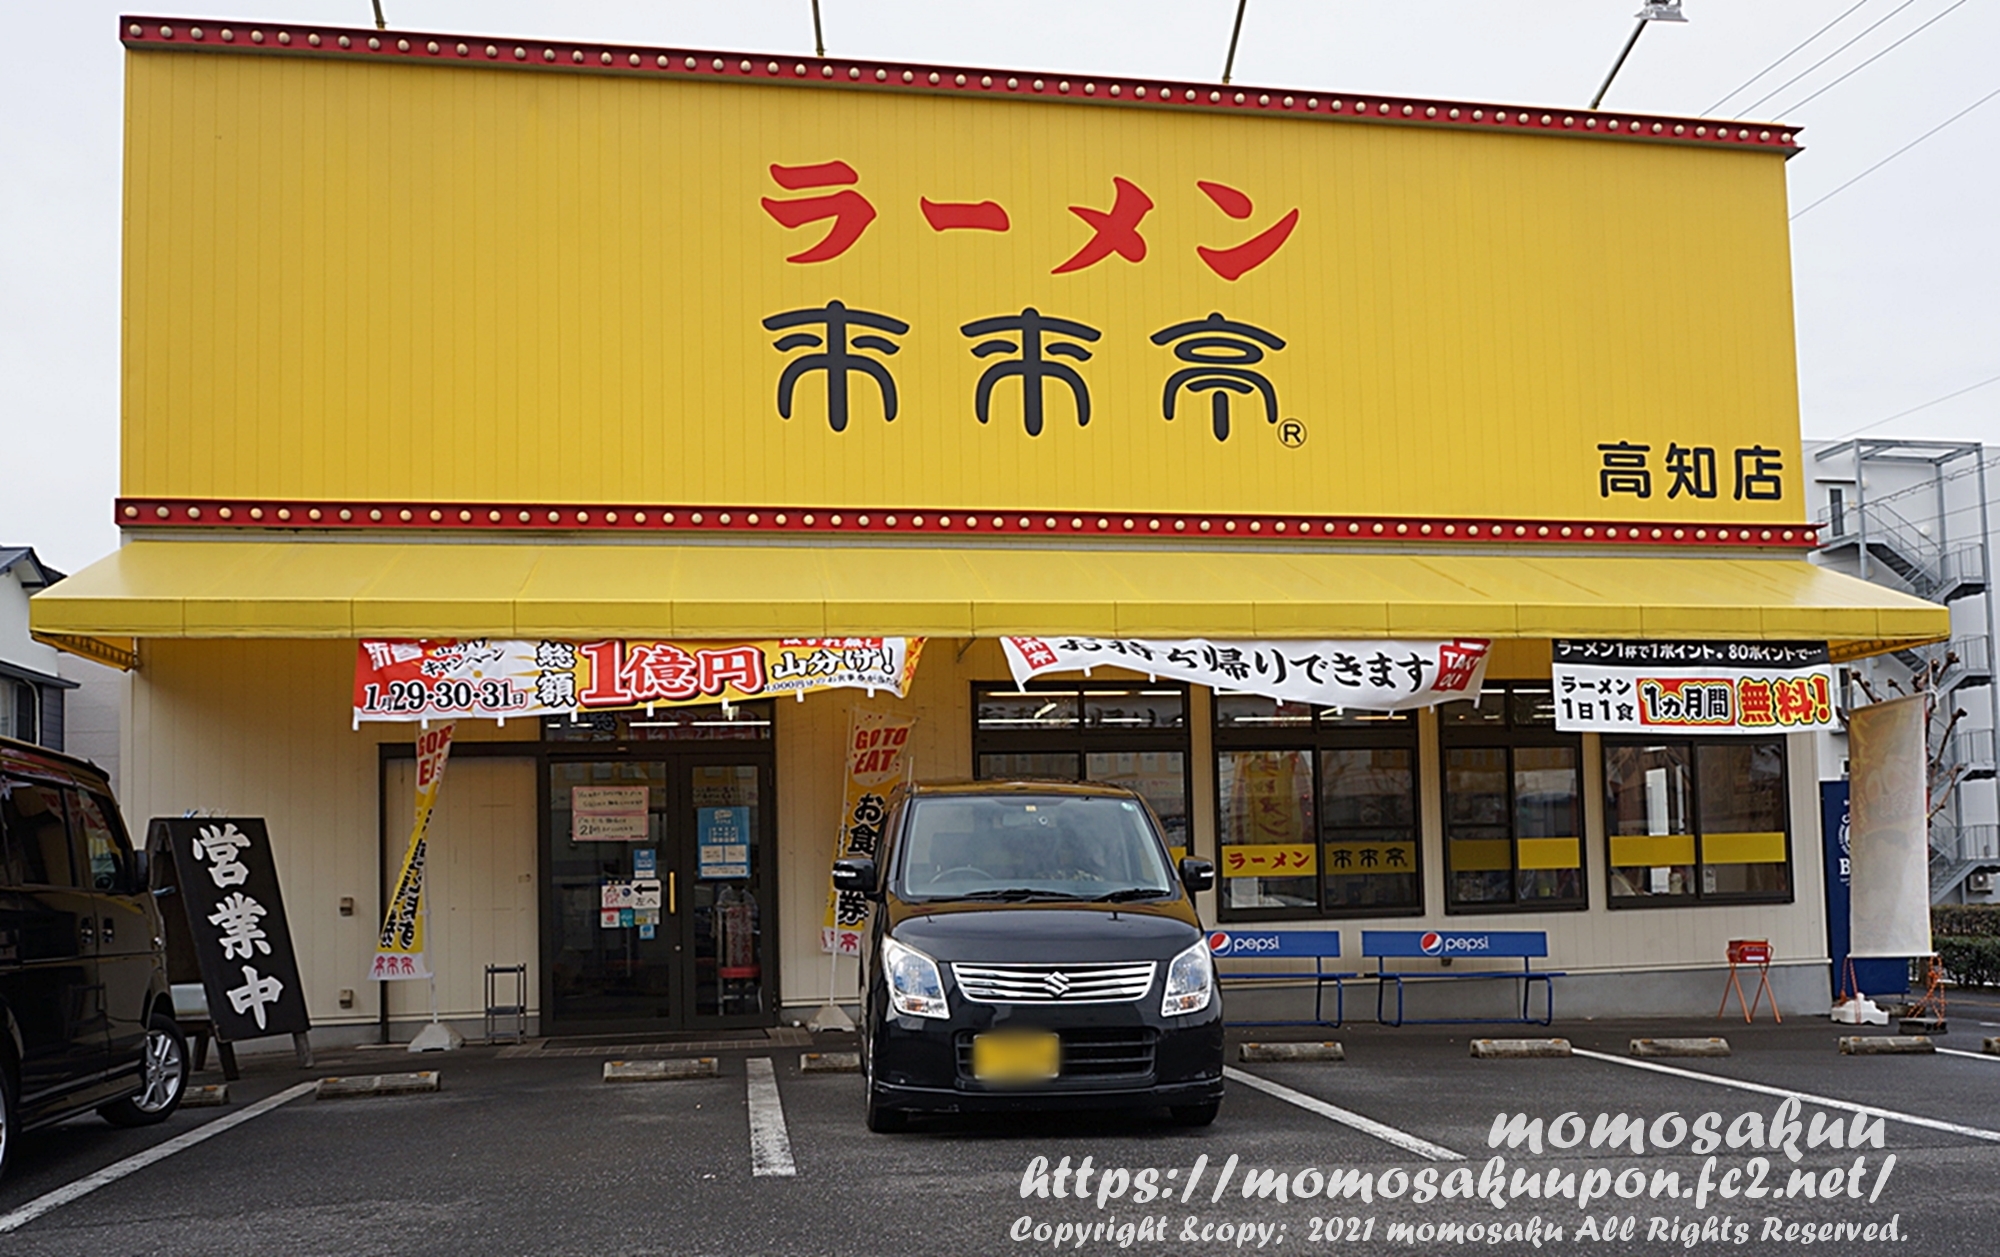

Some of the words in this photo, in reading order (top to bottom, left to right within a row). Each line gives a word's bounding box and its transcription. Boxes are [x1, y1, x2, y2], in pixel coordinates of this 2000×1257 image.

[760, 160, 1299, 281] ラーメン
[762, 300, 1287, 442] 来来亭
[1597, 440, 1783, 501] 高知店
[421, 648, 505, 677] キャンペーン
[535, 640, 577, 708] 総額
[579, 640, 766, 709] 1億円
[1561, 676, 1631, 696] ラーメン
[1562, 698, 1634, 721] 1日1食
[853, 748, 898, 775] EAT
[1228, 851, 1311, 870] ラーメン
[1332, 847, 1408, 869] 来来亭
[192, 823, 284, 1031] 営業中
[1233, 935, 1280, 952] pepsi
[1445, 935, 1490, 952] pepsi
